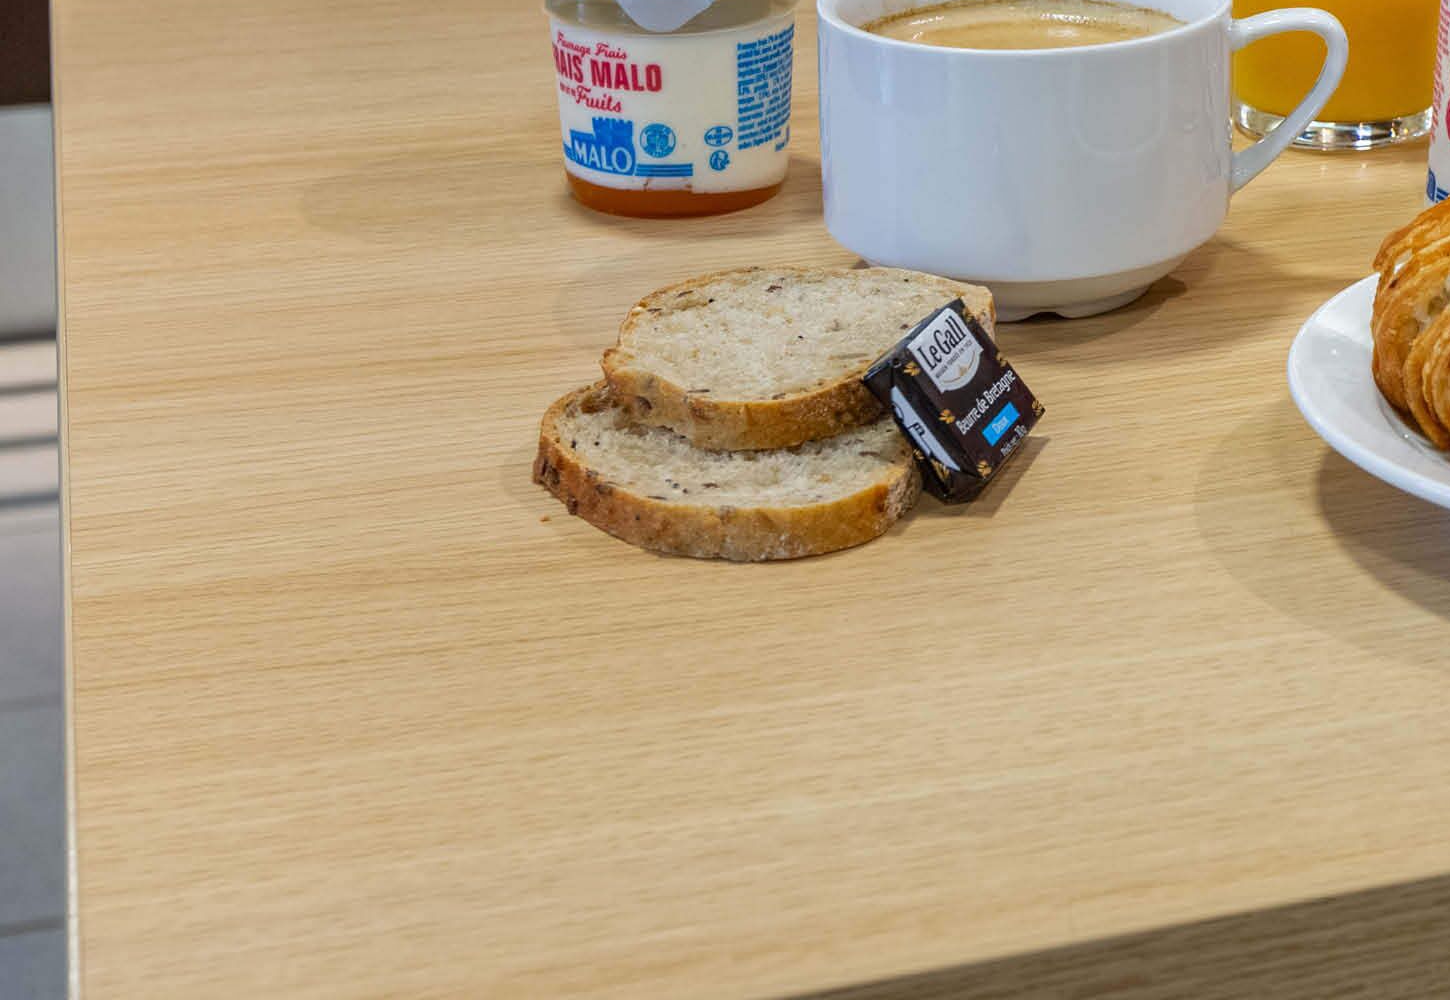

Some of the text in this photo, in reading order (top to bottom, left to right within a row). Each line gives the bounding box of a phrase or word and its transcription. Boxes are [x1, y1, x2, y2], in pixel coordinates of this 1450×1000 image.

[552, 42, 663, 93] RAIS MALO
[575, 85, 622, 114] Fruits
[573, 139, 632, 174] MALO
[982, 369, 1016, 405] Bretagne
[955, 407, 982, 436] Beurre
[975, 398, 990, 414] de
